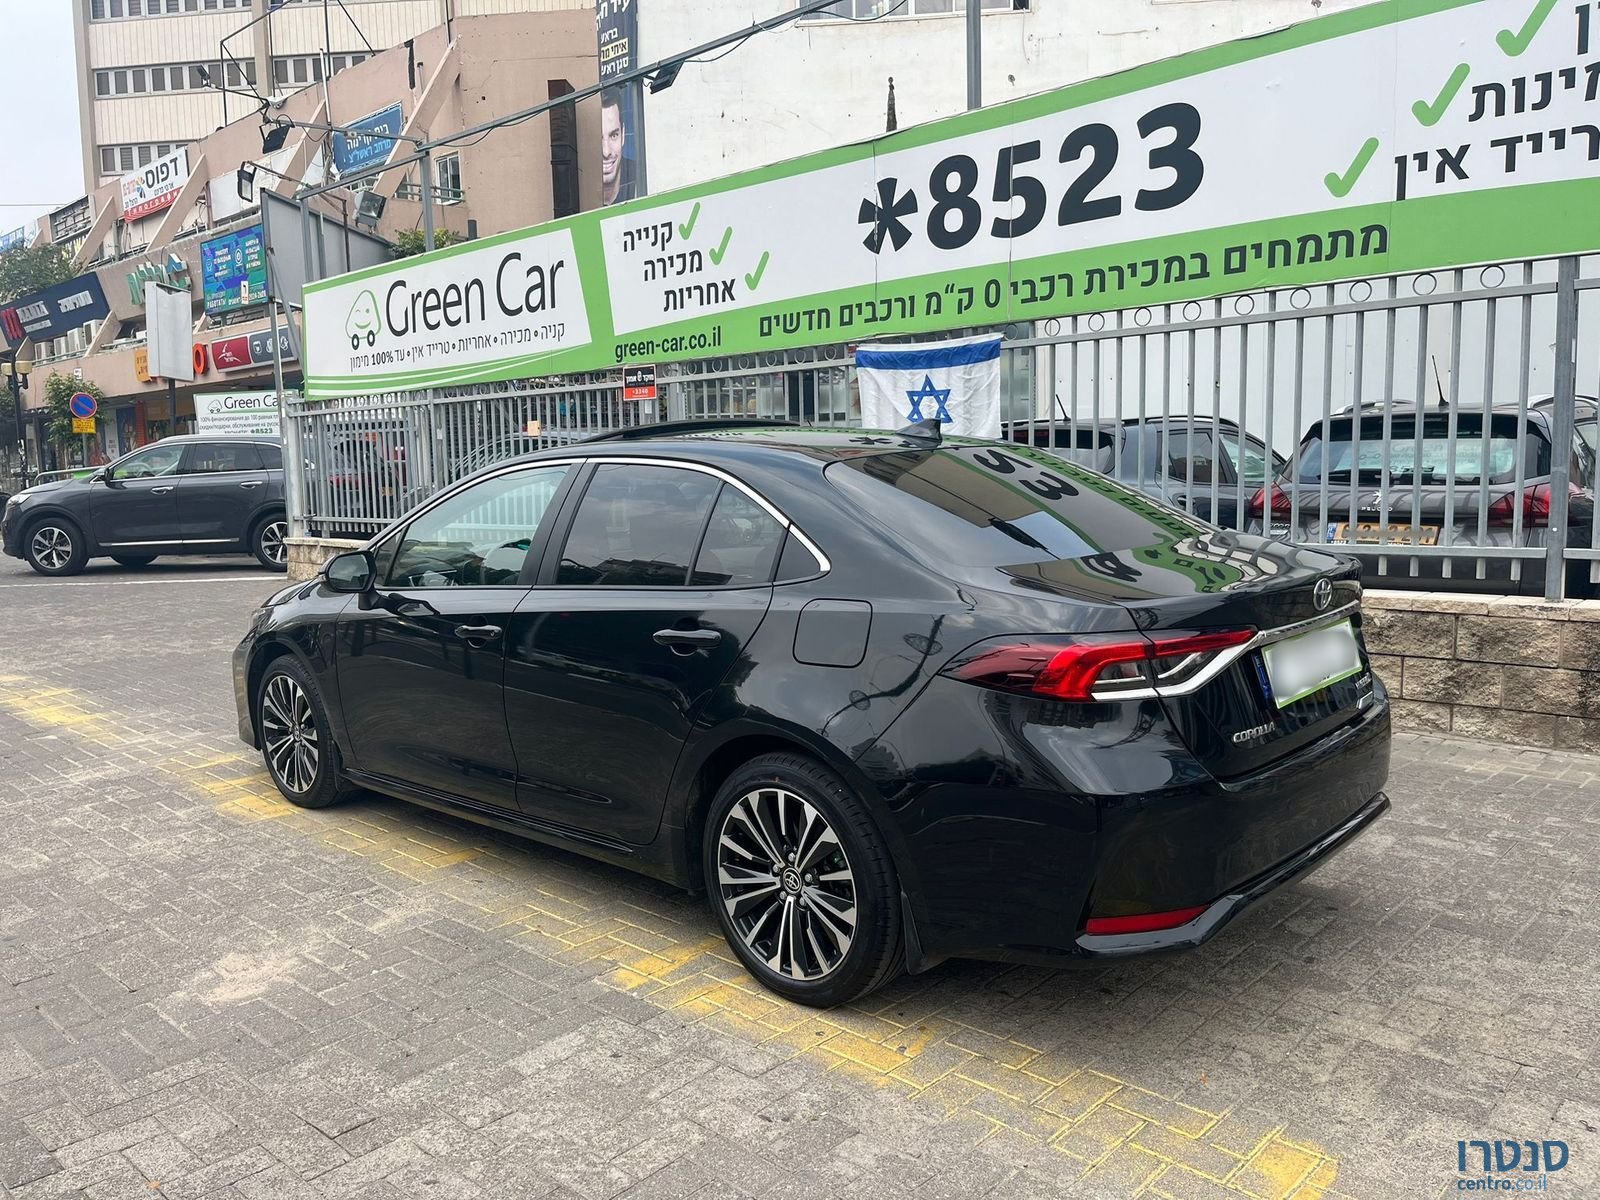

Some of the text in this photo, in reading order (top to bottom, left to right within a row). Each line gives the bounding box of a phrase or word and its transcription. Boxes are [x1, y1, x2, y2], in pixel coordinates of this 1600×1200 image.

[145, 157, 178, 189] דפוס
[1394, 144, 1471, 201] אין
[127, 191, 178, 216] Типографи
[623, 221, 673, 253] קנייה
[1223, 224, 1389, 276] מתמחים
[643, 250, 703, 282] מכירה
[1083, 252, 1210, 296] במכירת
[385, 252, 564, 337] Green Car
[663, 278, 736, 312] אחריות
[984, 278, 1001, 308] 0
[1009, 272, 1074, 305] רכבי
[759, 307, 831, 337] חדשים
[839, 295, 915, 328] ורכבים
[349, 322, 565, 373] קניה מכירה אחריות טרייד אין עד 100% מימון
[615, 325, 721, 363] green-car.co.il
[224, 395, 278, 409] Green Ca
[1233, 721, 1276, 743] COROLLA
